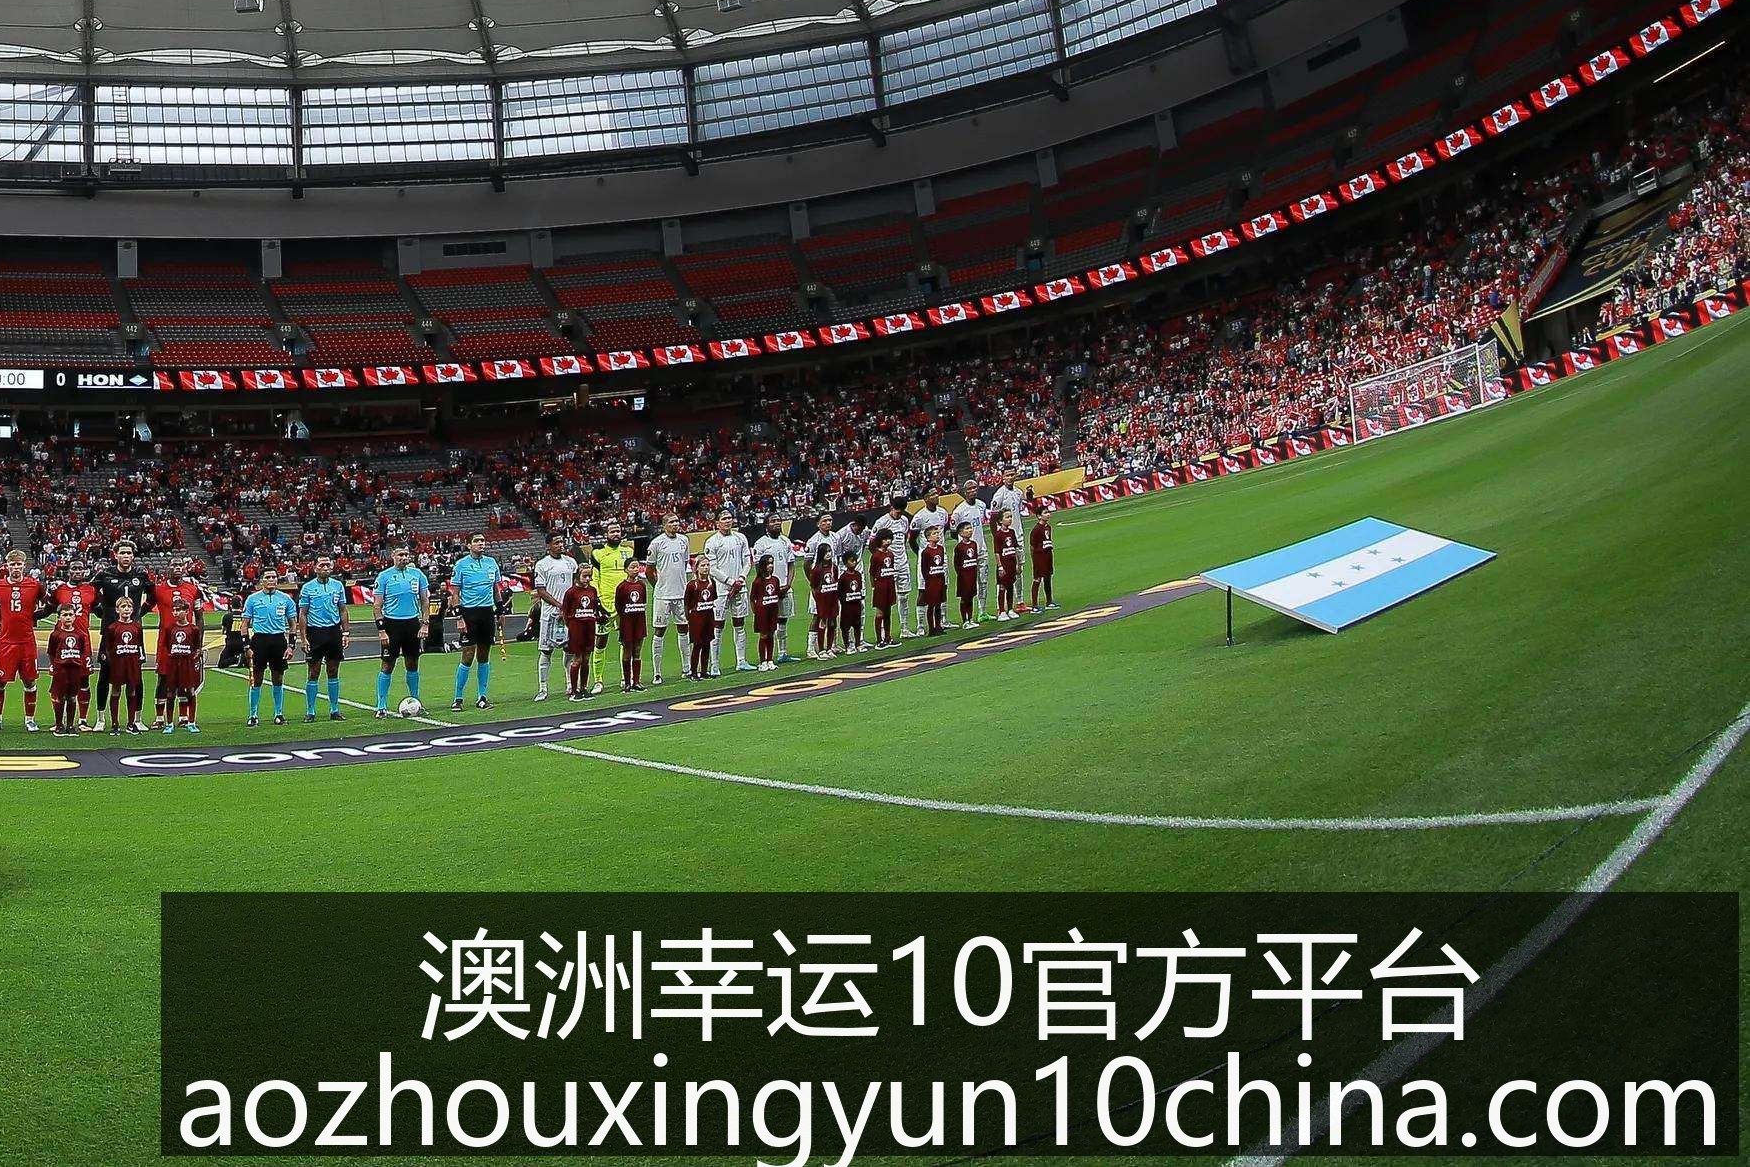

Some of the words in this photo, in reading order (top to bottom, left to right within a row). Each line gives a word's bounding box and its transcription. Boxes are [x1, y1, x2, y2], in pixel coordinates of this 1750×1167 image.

[56, 372, 66, 387] 0
[78, 374, 124, 387] HON
[672, 552, 679, 562] 15
[10, 600, 22, 612] 15
[119, 711, 663, 768] Concacaf
[667, 652, 958, 711] GOLD
[956, 605, 1123, 650] CUP
